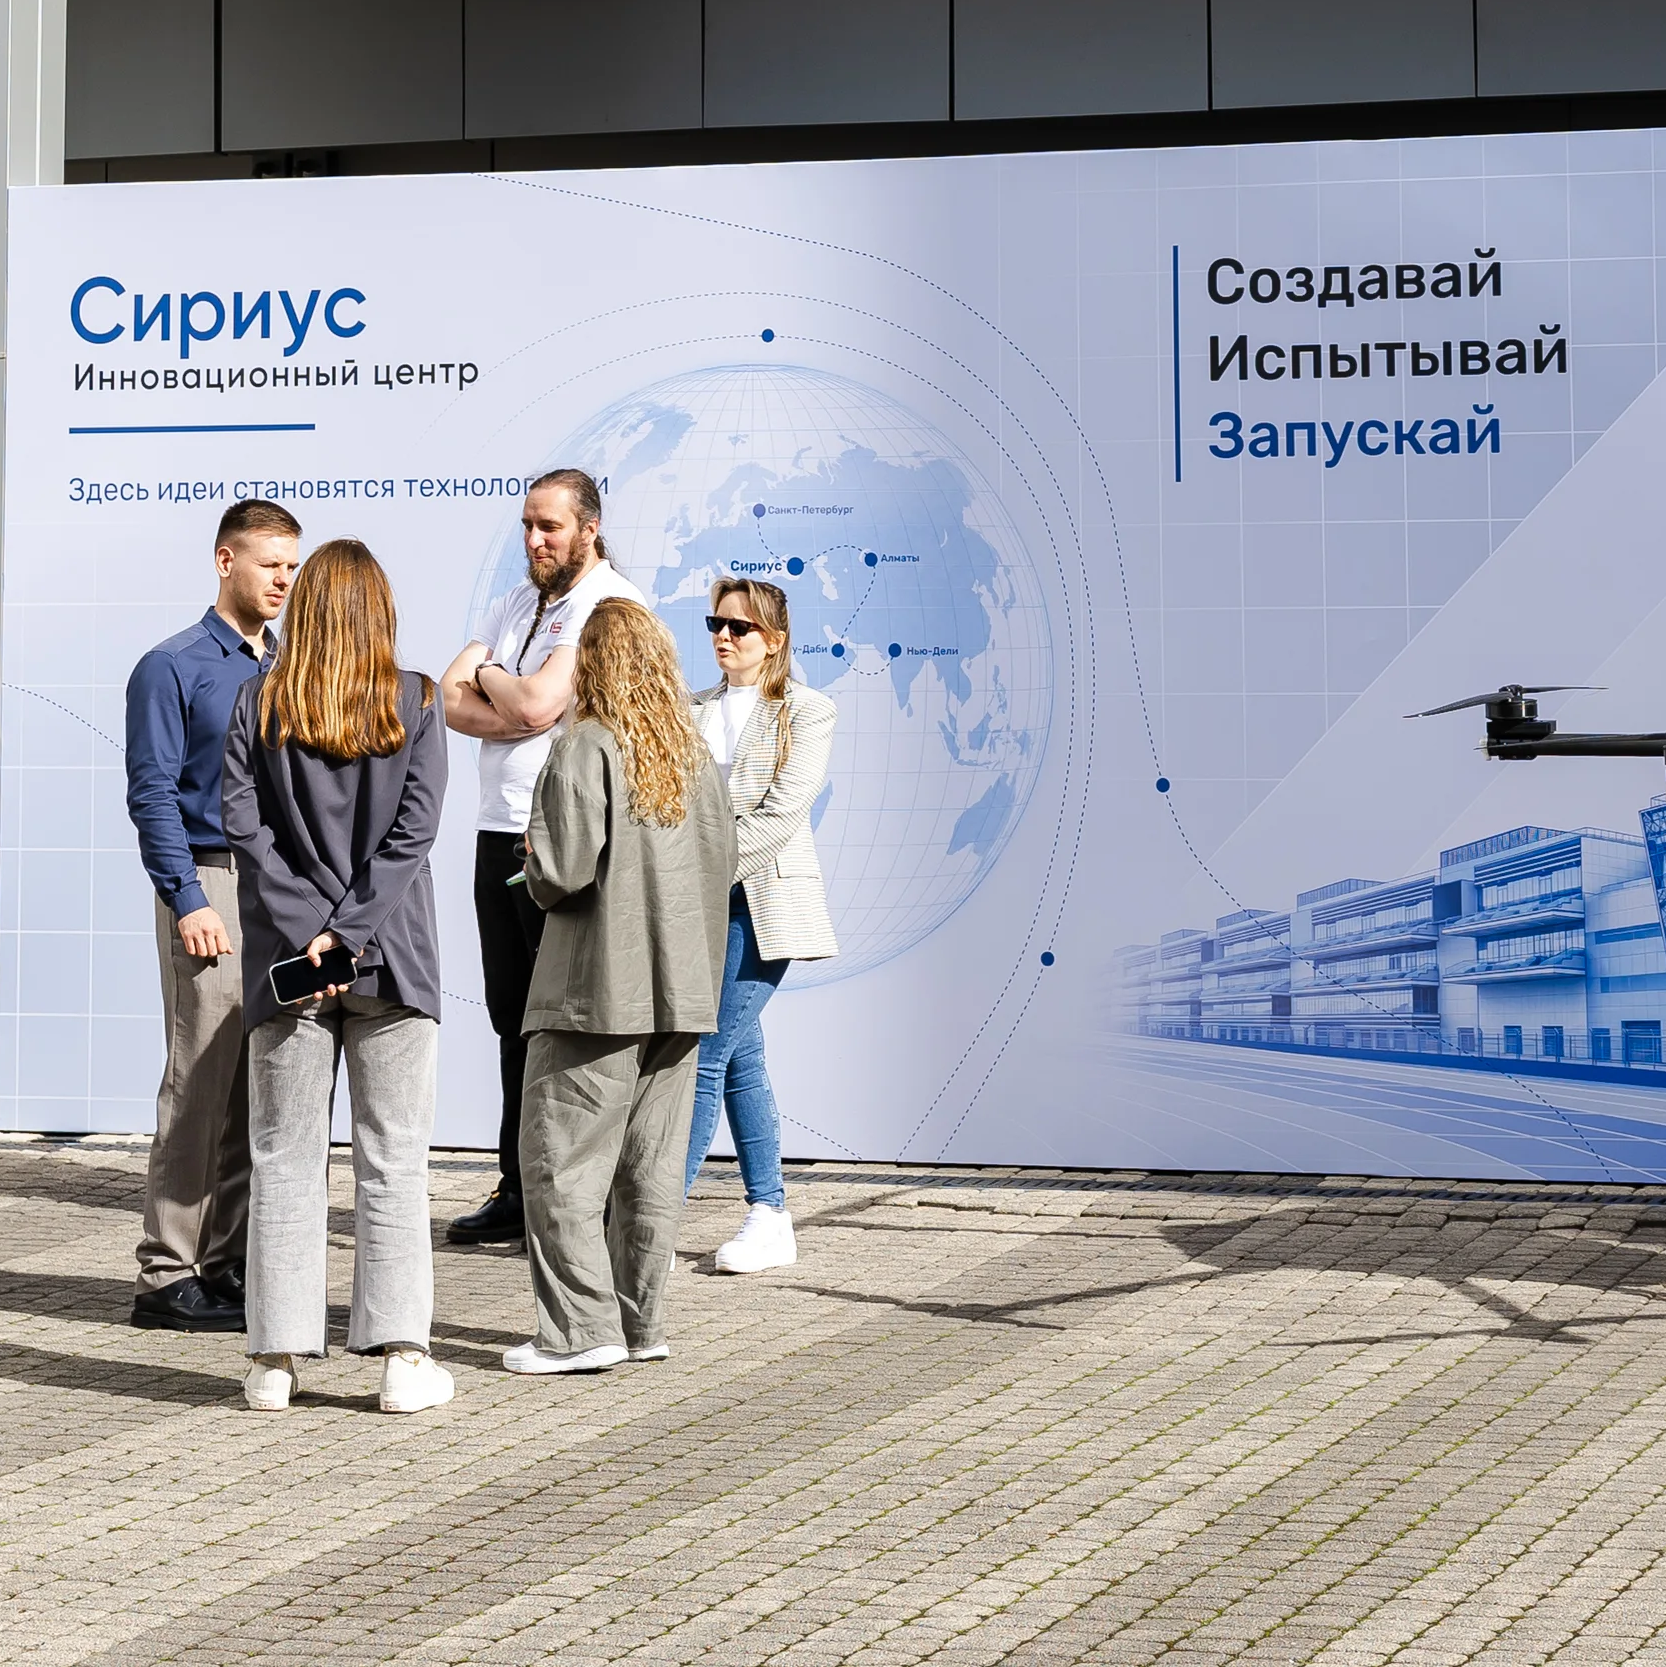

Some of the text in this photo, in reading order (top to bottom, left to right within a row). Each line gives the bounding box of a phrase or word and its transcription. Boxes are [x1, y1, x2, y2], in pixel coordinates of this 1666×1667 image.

[1206, 246, 1503, 309] Создавай
[69, 275, 368, 360] Сириус
[1207, 323, 1568, 382] Испытывай
[73, 359, 480, 393] Инновационный центр
[1207, 403, 1502, 469] Запускай
[68, 476, 609, 504] Здесь идеи становятся технологи
[767, 505, 854, 516] Санкт-Петербург
[729, 560, 783, 574] Сириус
[880, 553, 920, 563] Алматы
[792, 644, 828, 655] у-Даби
[906, 646, 960, 657] Нью-Дели
